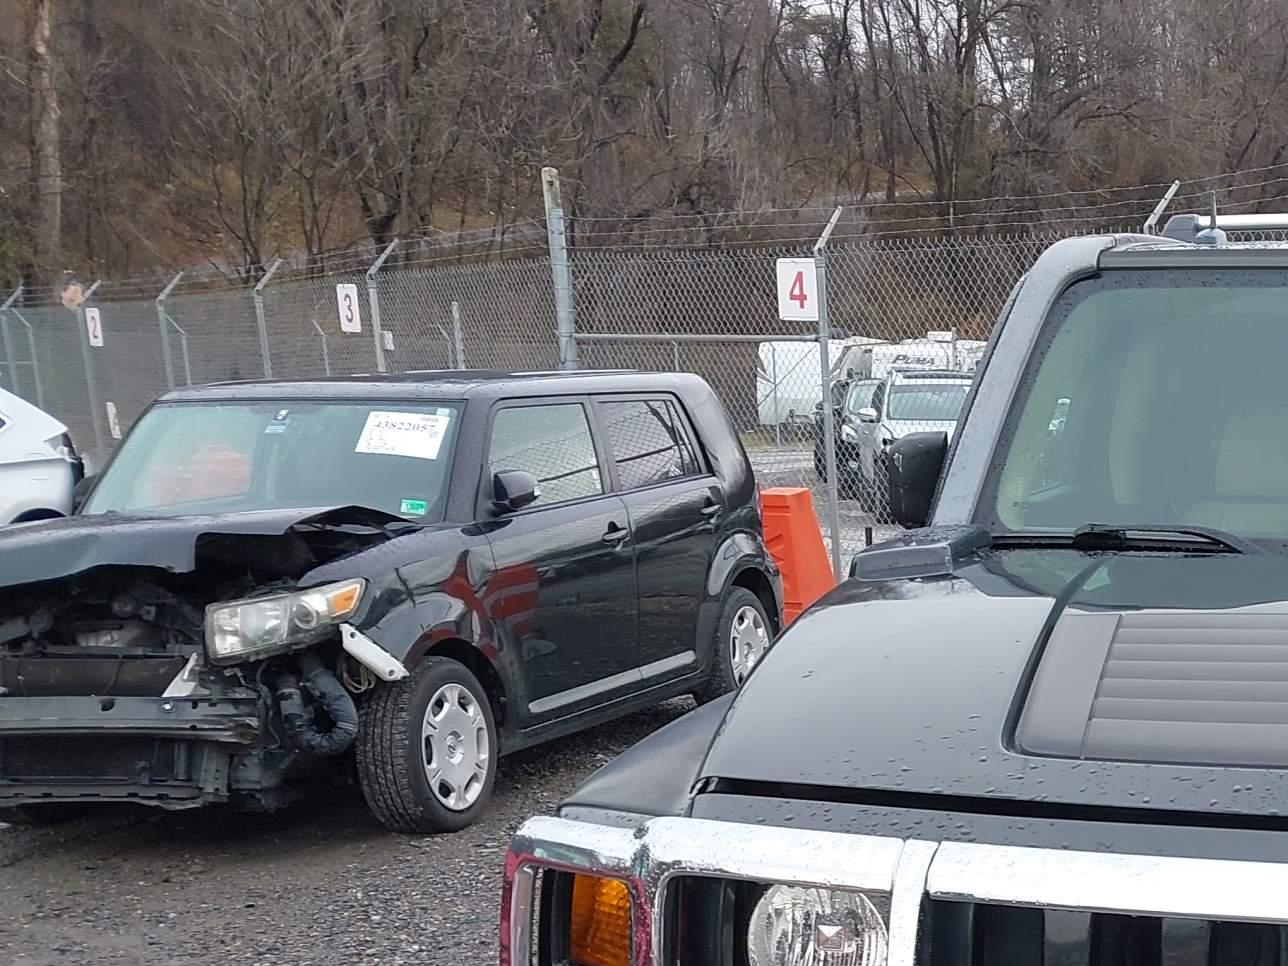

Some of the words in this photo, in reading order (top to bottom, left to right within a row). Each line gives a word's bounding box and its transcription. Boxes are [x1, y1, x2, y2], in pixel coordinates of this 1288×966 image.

[789, 271, 807, 309] 4
[344, 293, 353, 323] 3
[90, 315, 98, 339] 2
